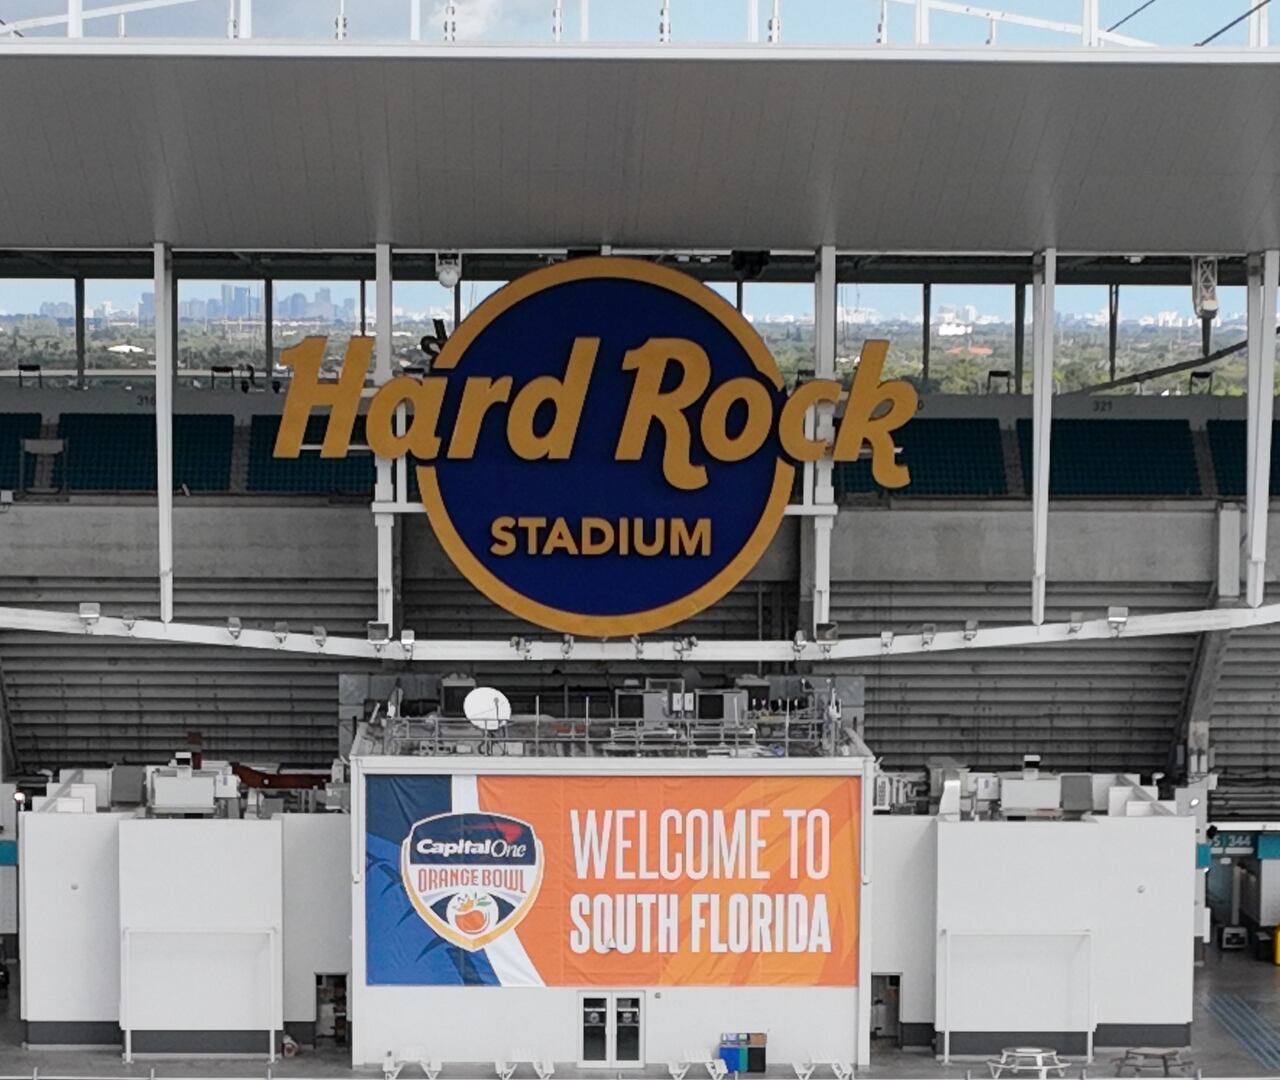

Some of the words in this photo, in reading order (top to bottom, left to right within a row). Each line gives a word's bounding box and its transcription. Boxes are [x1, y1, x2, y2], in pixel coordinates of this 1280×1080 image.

[272, 336, 601, 461] Hard
[614, 337, 919, 491] Rock
[489, 516, 713, 558] STADIUM
[569, 807, 772, 882] WELCOME
[782, 807, 831, 880] TO
[1228, 835, 1252, 847] 344
[418, 867, 480, 893] ORANGE
[482, 868, 527, 894] BOWL
[569, 892, 678, 955] SOUTH
[689, 892, 832, 954] FLORIDA
